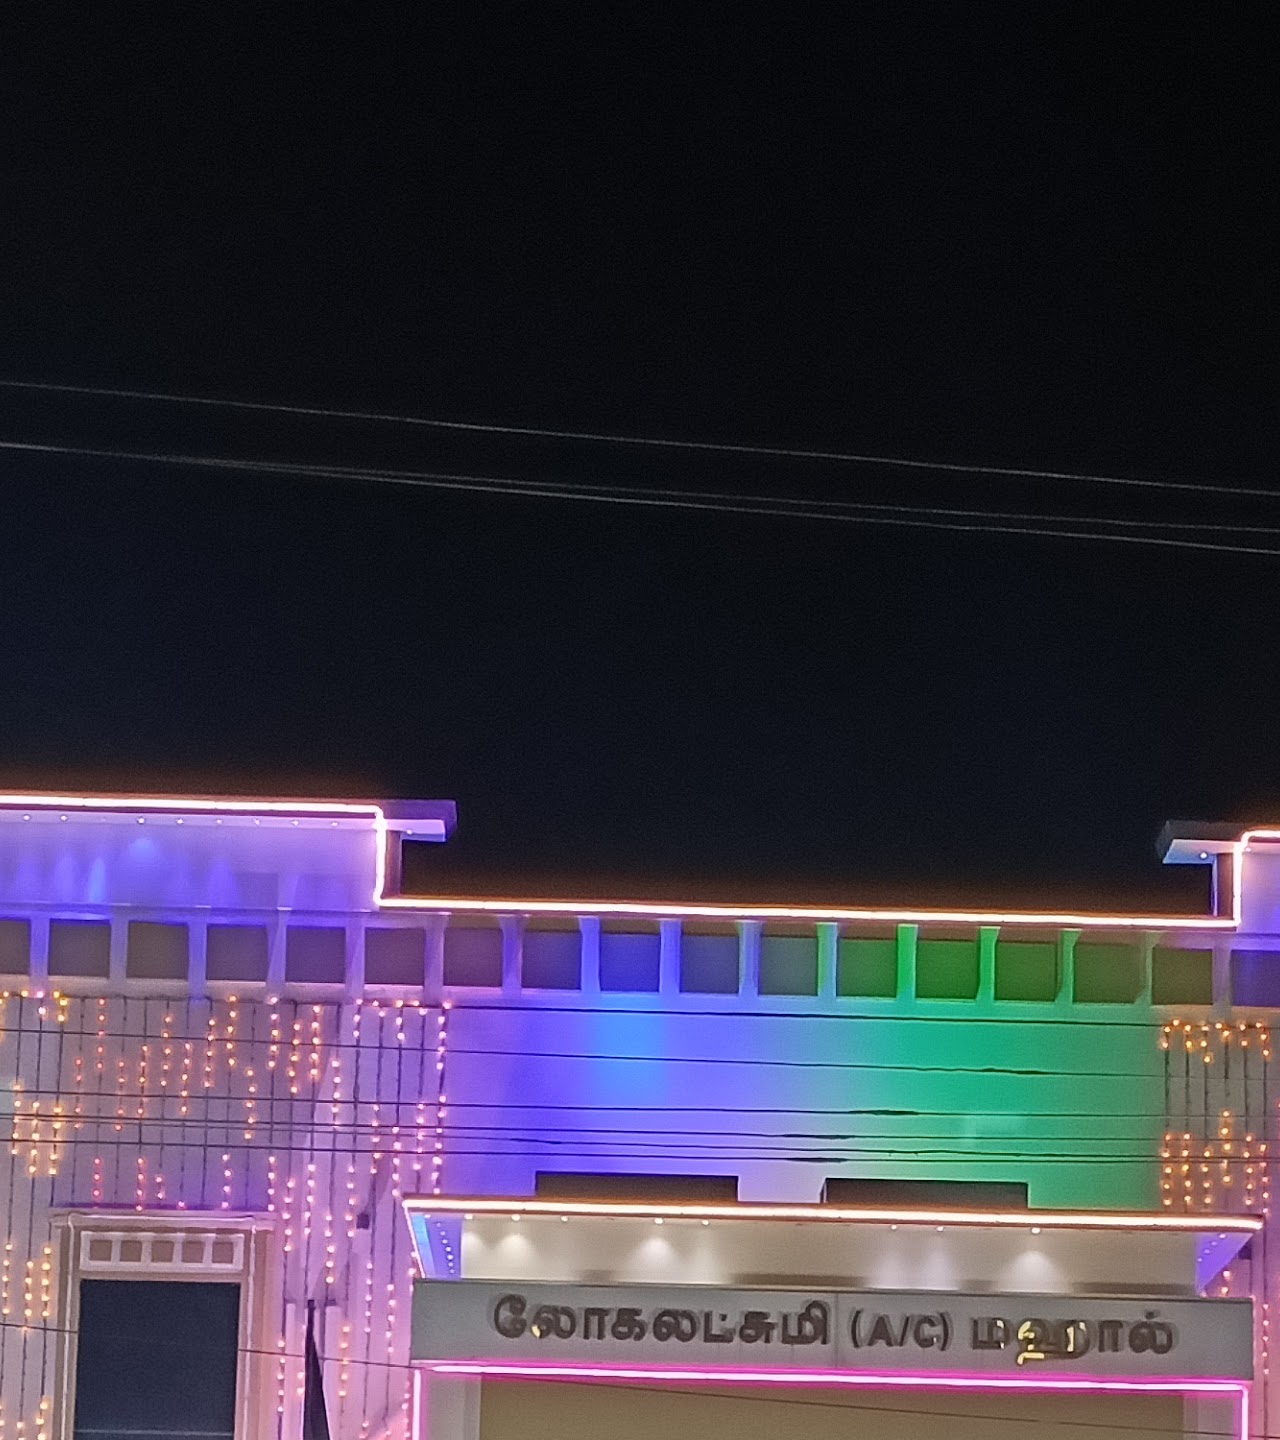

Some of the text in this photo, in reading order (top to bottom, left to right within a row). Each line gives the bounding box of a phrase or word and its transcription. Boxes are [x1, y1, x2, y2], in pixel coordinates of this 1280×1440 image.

[494, 1294, 1176, 1366] லோகலட்சுமி (A/C) மஹால்
